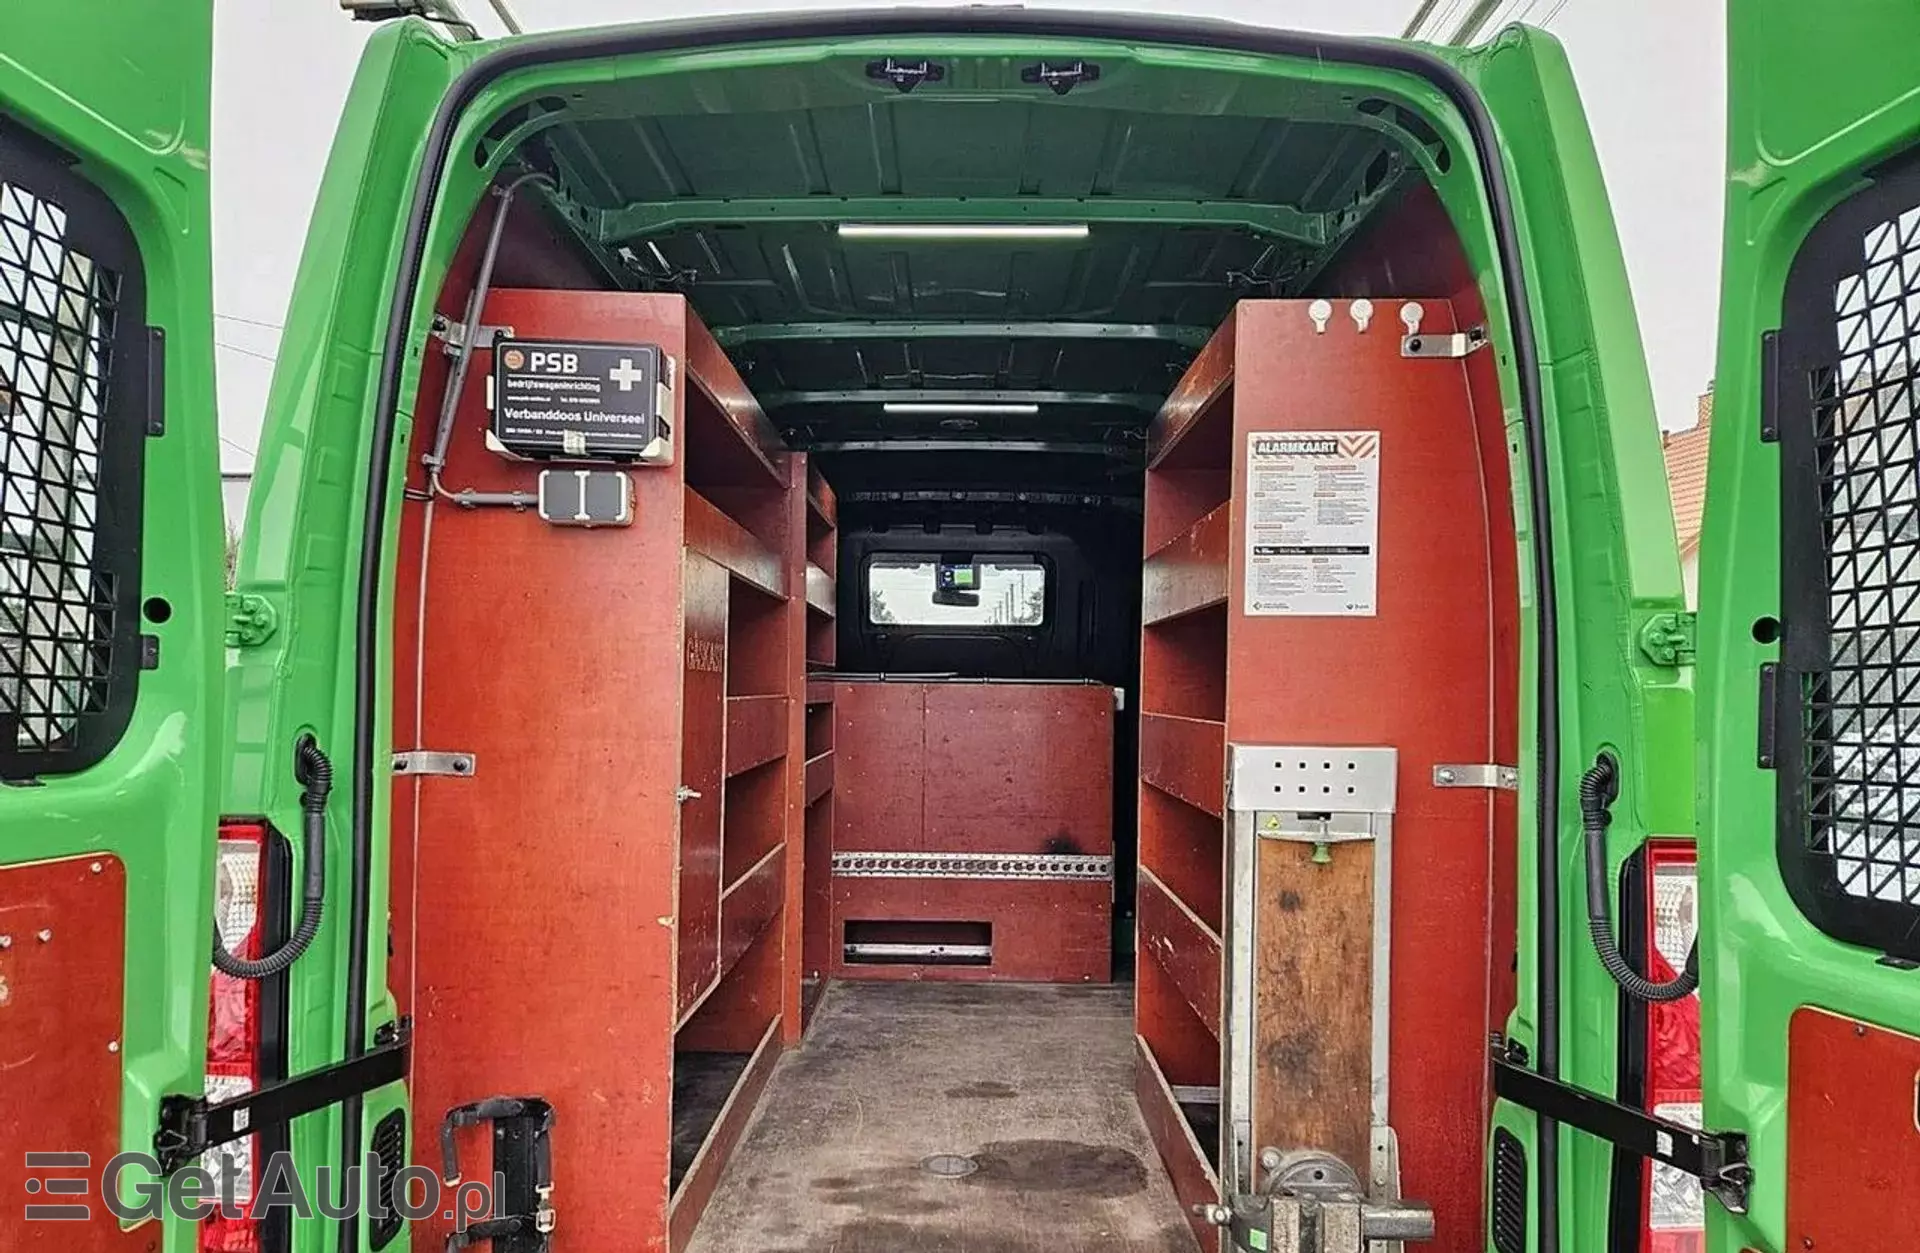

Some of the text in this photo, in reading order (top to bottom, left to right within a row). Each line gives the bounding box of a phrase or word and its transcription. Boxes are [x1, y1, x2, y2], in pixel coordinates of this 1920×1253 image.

[530, 352, 579, 374] PSB
[503, 407, 646, 426] Verbanddoos Universeel
[1257, 441, 1337, 453] ALARMKAART
